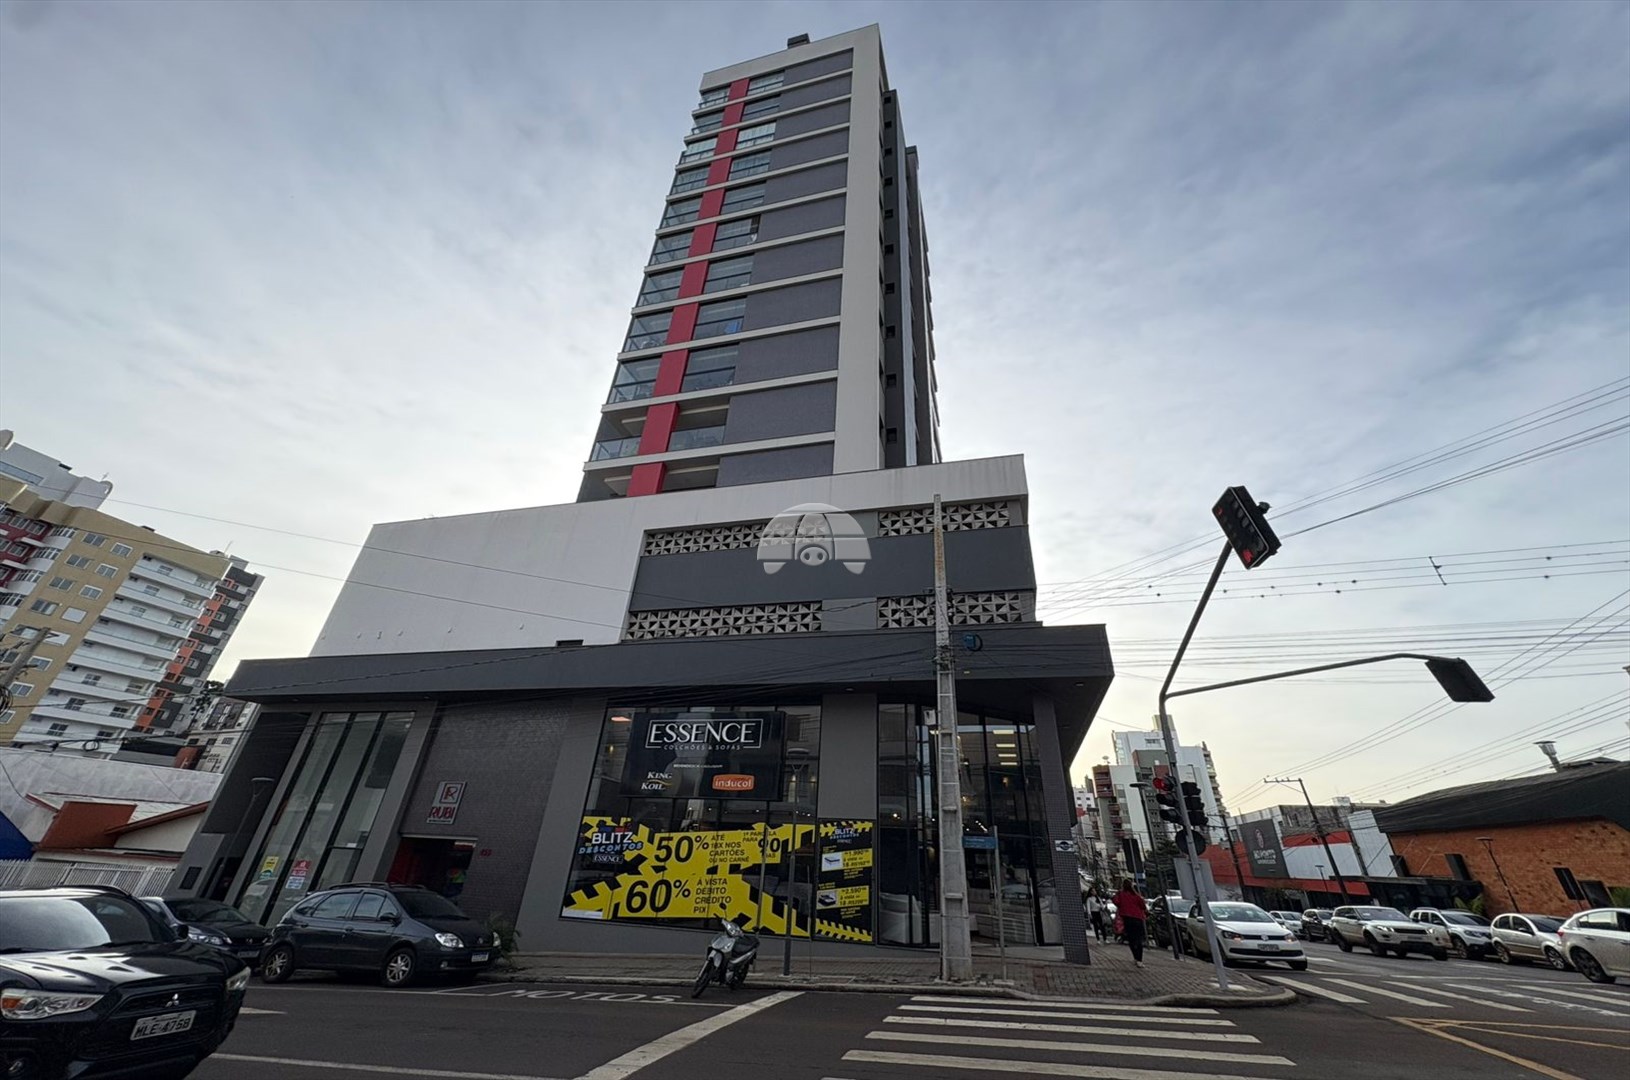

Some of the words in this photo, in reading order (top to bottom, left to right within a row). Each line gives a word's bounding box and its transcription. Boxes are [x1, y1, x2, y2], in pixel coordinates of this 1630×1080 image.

[650, 721, 756, 743] ESSENCE
[647, 771, 673, 779] KING
[641, 782, 665, 790] KOIL
[715, 778, 752, 788] inducol
[429, 806, 456, 819] RUBI
[592, 831, 633, 844] BLITZ
[579, 842, 643, 854] DESCONTOS
[654, 835, 709, 864] 50%
[593, 854, 621, 862] ESSENCE
[626, 879, 691, 913] 60%
[693, 906, 706, 914] PIX
